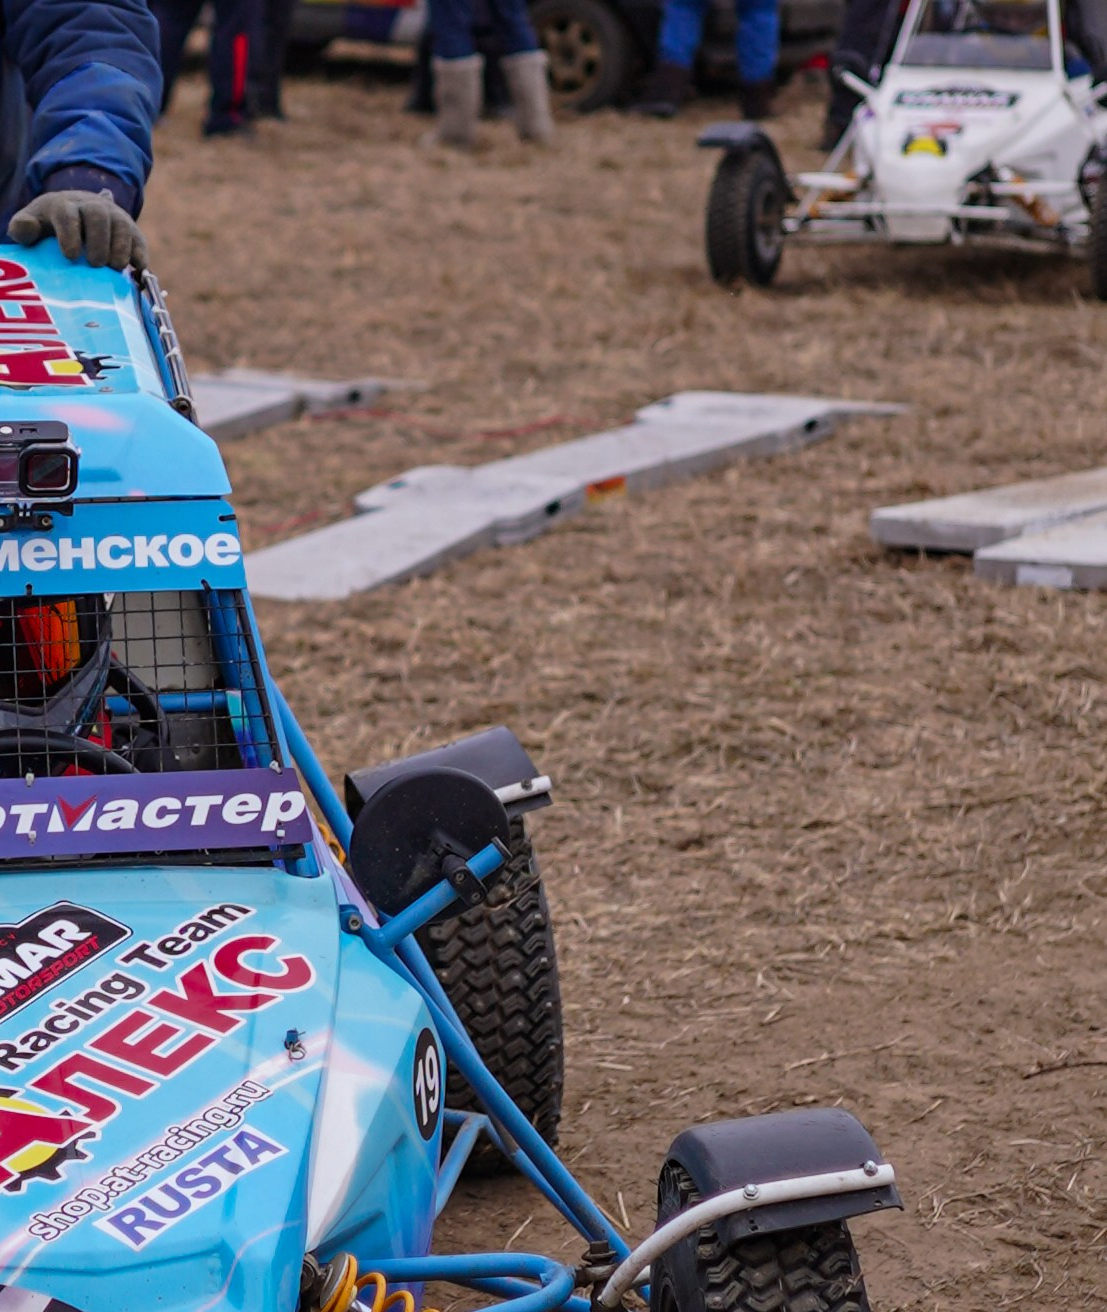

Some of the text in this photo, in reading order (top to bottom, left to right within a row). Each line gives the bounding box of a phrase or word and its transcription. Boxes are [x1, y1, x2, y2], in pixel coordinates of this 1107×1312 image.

[119, 903, 253, 969] Team
[415, 1044, 440, 1127] 19
[28, 1079, 271, 1241] shop.at-racing.ru
[106, 1129, 282, 1247] RUSTA
